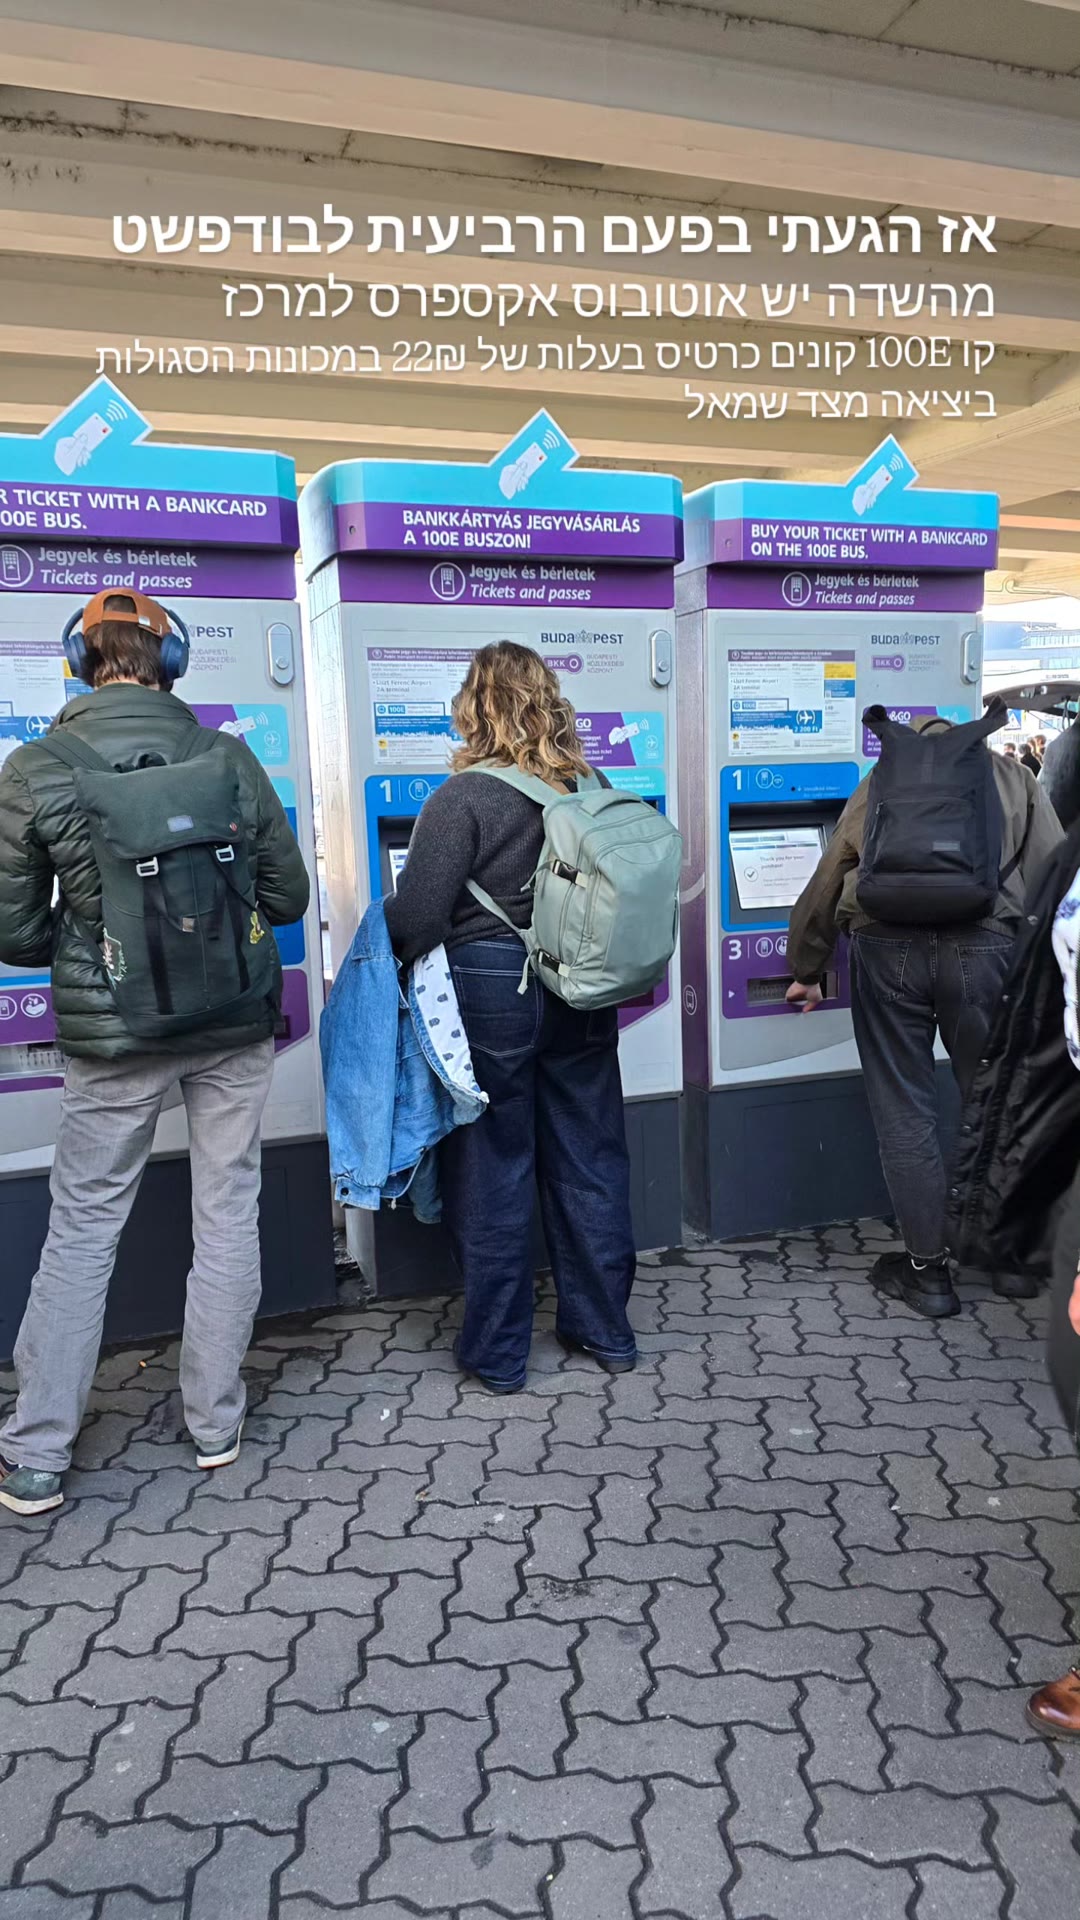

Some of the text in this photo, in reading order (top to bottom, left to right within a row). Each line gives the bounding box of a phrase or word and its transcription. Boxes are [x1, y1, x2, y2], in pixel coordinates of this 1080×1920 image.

[13, 489, 81, 508] TICKET
[87, 492, 140, 511] WITH
[146, 496, 161, 512] A
[166, 496, 267, 517] BANKCARD
[0, 510, 87, 530] 00E BUS.
[402, 509, 641, 533] BANKKÁRTYÁS JEGYVÁSÁRLÁS
[403, 531, 531, 549] A 100E BUSZON!
[751, 524, 988, 547] BUY YOUR TICKET WITH A BANKCARD
[38, 547, 198, 568] Jegyek és bérletek
[751, 541, 869, 560] ON THE 100E BUS.
[40, 569, 192, 590] Tickets and passes
[469, 564, 596, 582] Jegyek és bérletek
[814, 573, 919, 589] Jegyek és bérletek
[470, 583, 591, 602] Tickets and passes
[815, 590, 915, 607] Tickets and passes
[888, 711, 911, 721] &GO
[732, 769, 742, 790] 1
[379, 779, 392, 802] 1
[728, 939, 742, 960] 3
